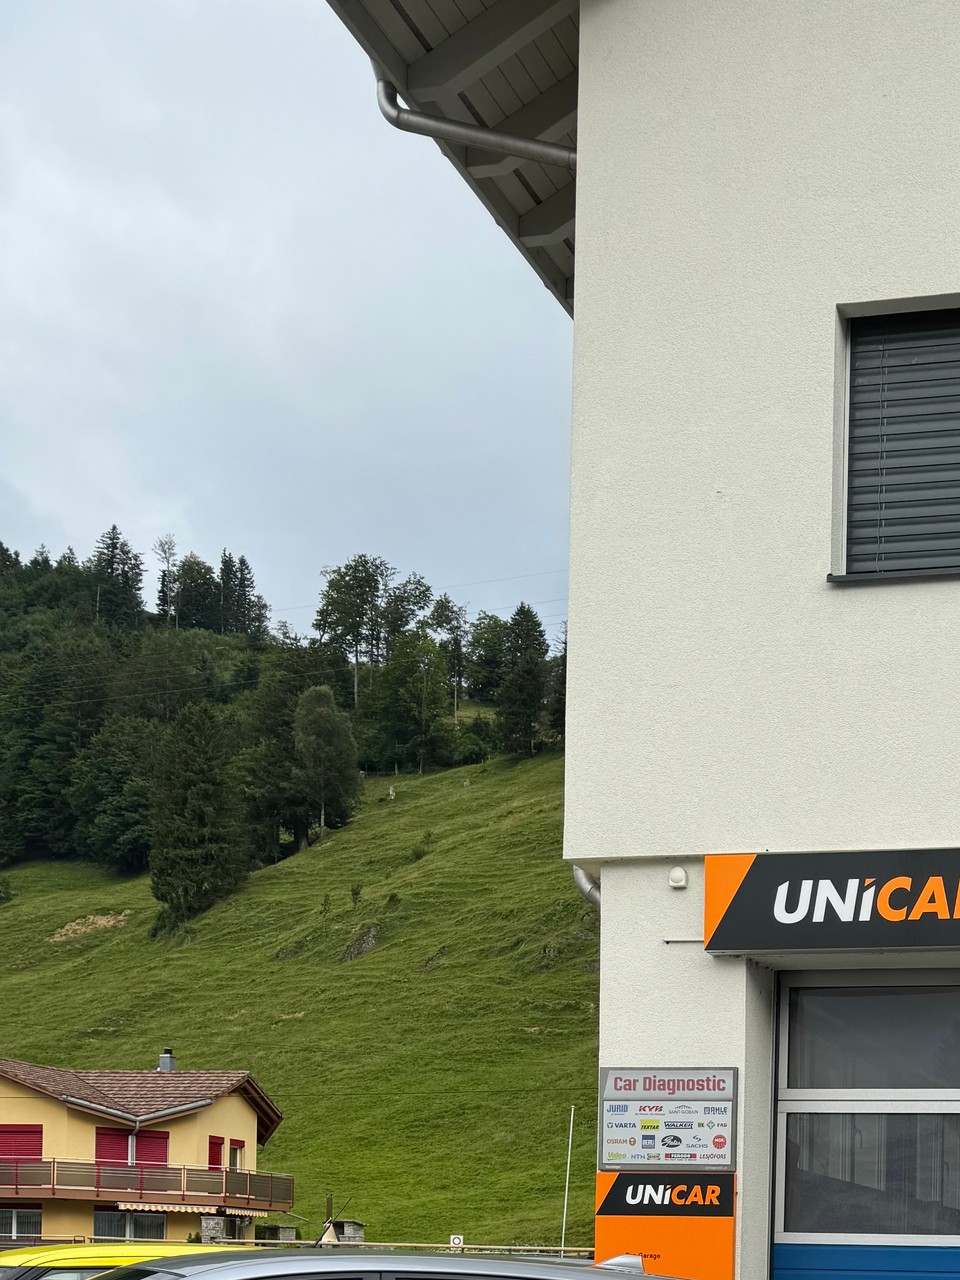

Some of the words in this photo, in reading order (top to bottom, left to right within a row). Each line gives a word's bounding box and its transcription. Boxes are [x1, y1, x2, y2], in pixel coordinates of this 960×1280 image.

[613, 1076, 639, 1091] Car
[643, 1075, 726, 1095] Diagnostic
[607, 1104, 629, 1113] JURID
